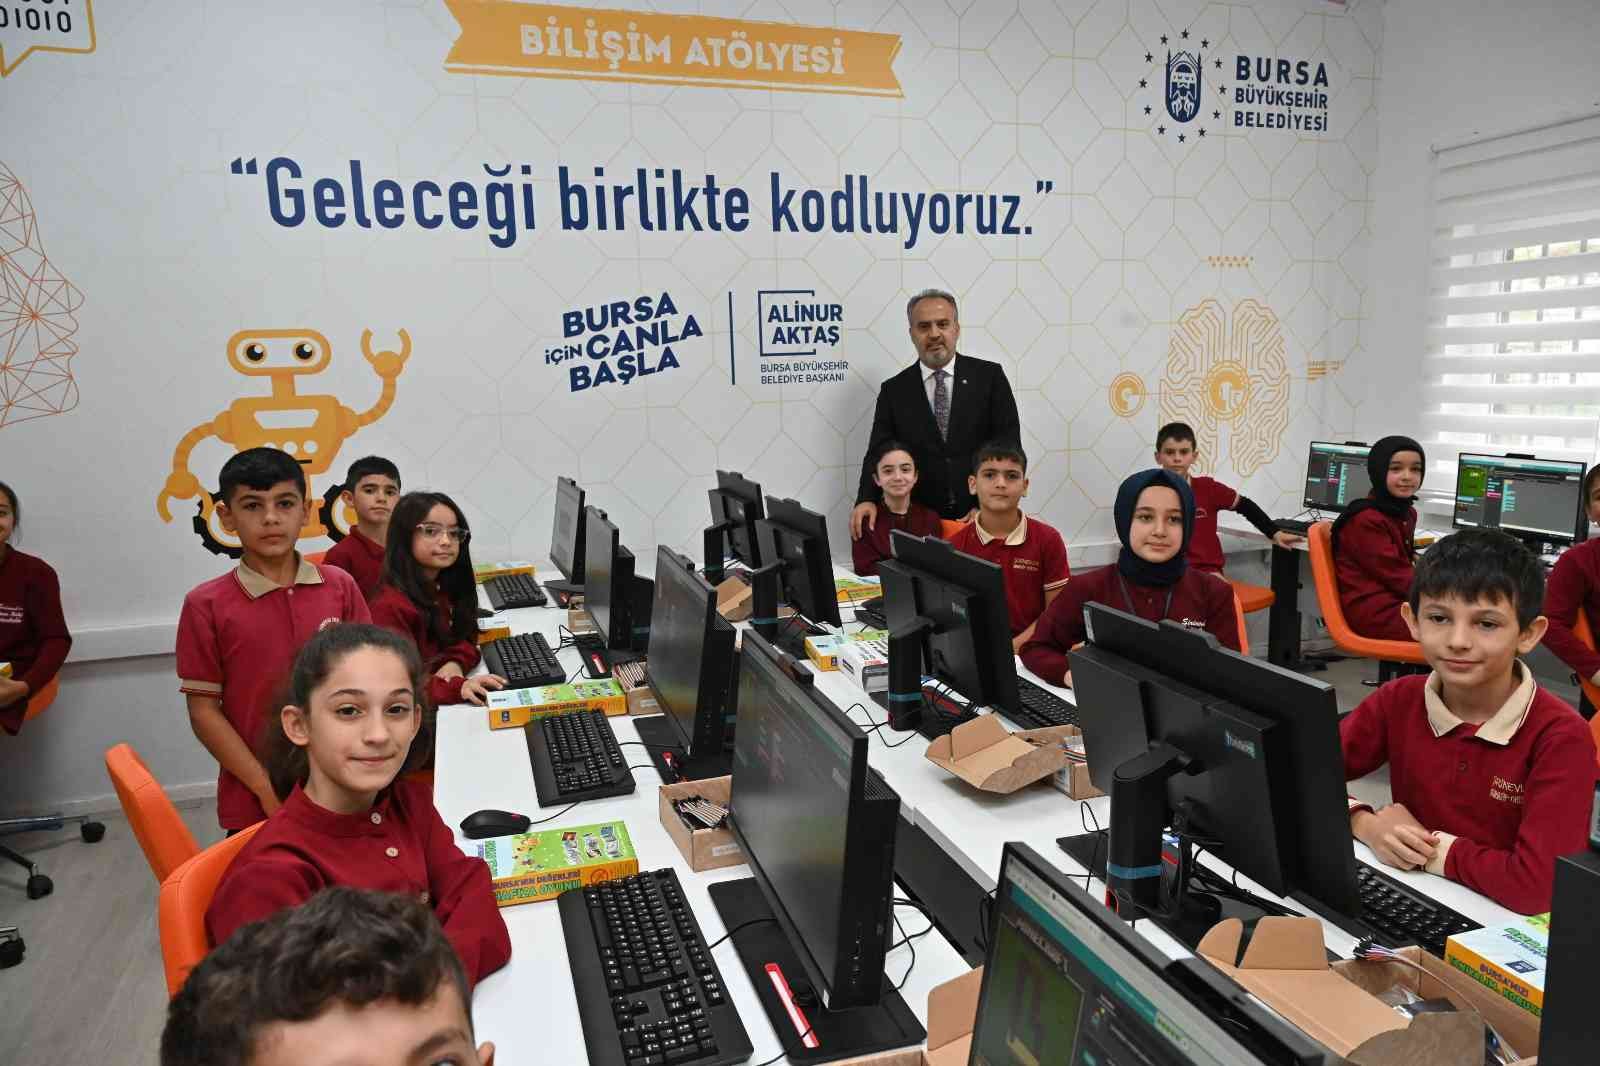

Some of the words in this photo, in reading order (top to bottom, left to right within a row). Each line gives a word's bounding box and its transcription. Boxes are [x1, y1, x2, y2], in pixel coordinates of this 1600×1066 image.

[520, 16, 671, 70] BİLİŞİM
[684, 31, 845, 74] ATÖLYESİ
[1236, 55, 1328, 87] BURSA
[1234, 110, 1327, 131] BELEDİYESİ
[559, 166, 749, 232] birlikte
[563, 292, 678, 338] BURSA
[768, 300, 843, 322] ALİNUR
[586, 314, 703, 360] CANLA
[772, 326, 840, 346] AKTAŞ
[570, 346, 680, 392] BAŞLA
[760, 362, 791, 373] BURSA
[793, 360, 848, 373] BÜYÜKŞEHİR
[761, 374, 803, 384] BELEDİYE
